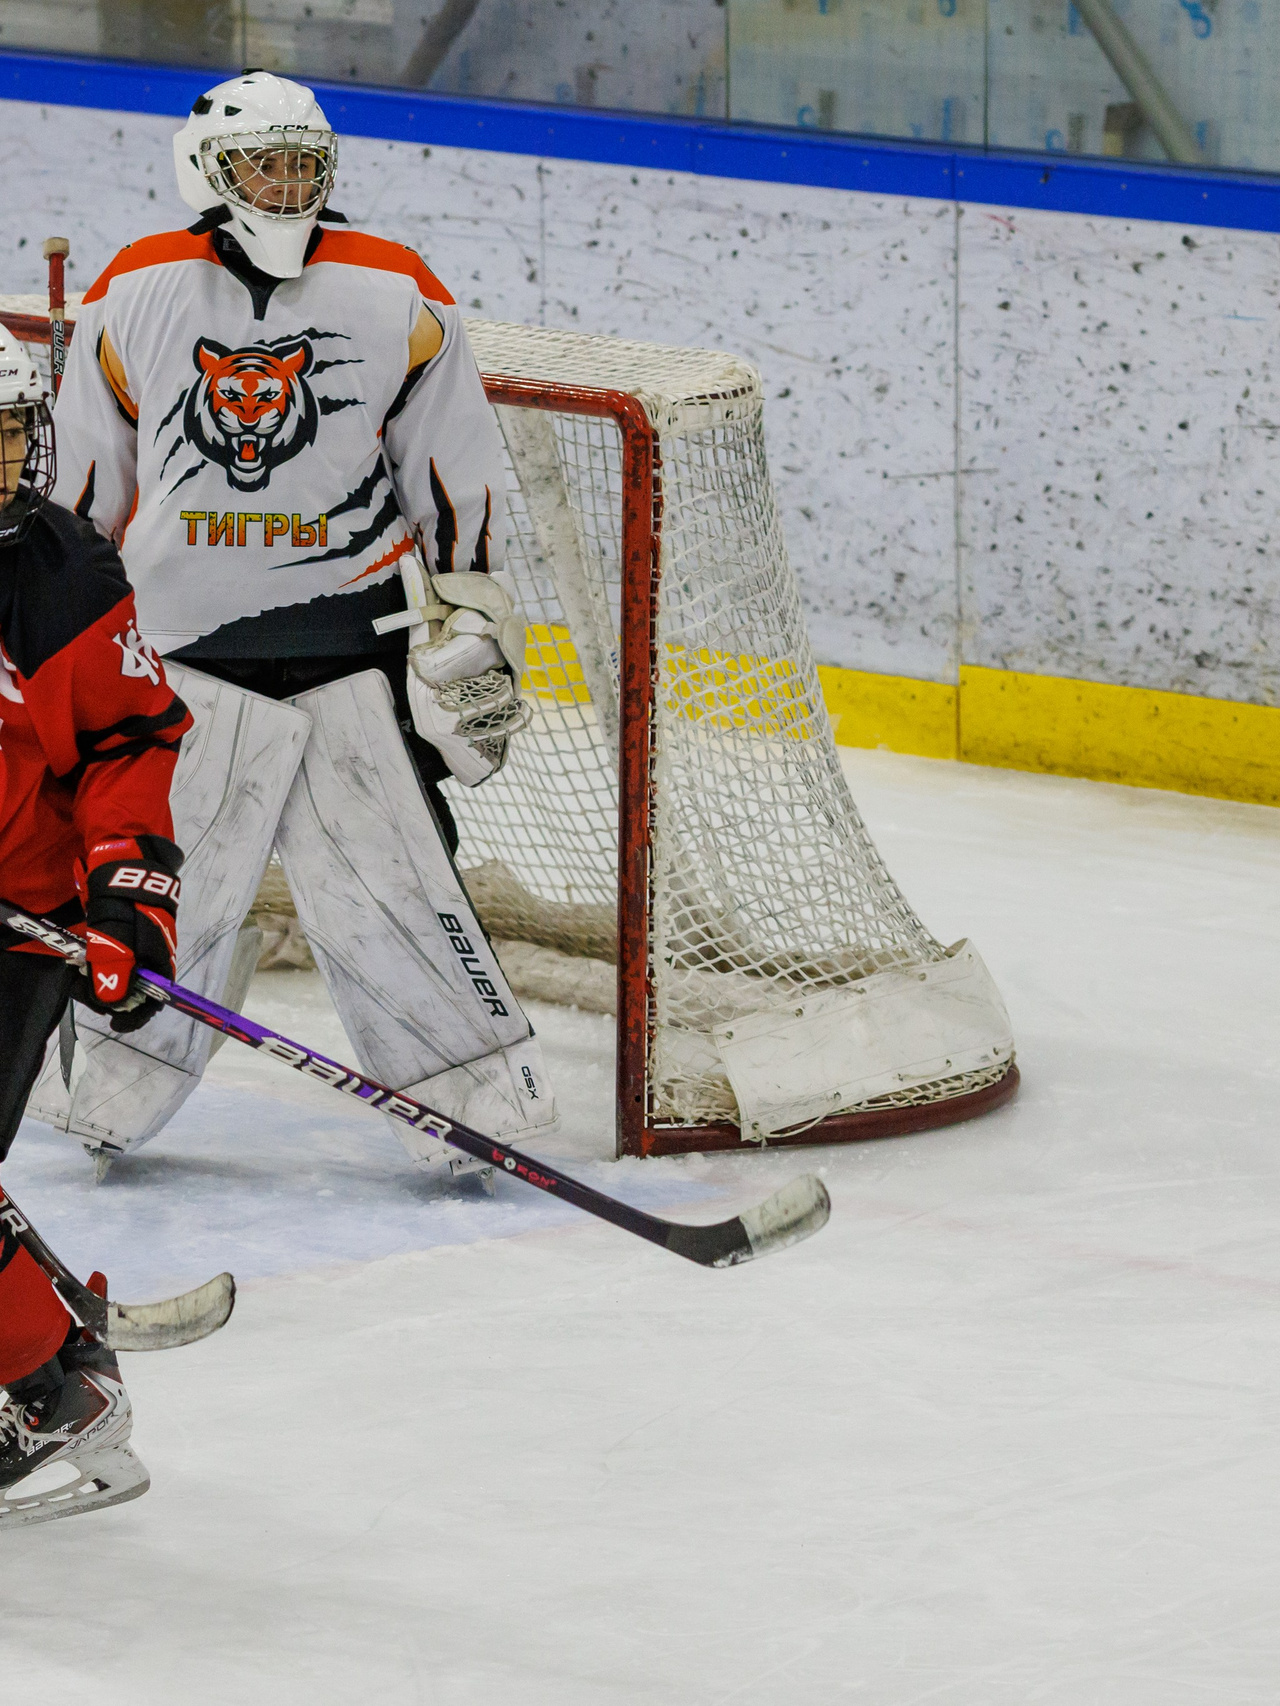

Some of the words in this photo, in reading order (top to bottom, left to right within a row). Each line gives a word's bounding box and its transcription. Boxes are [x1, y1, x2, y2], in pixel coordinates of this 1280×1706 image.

[53, 319, 66, 375] AUER
[179, 511, 328, 547] ТИГРЫ
[436, 912, 510, 1018] BAUER
[258, 1036, 454, 1143] BAUER
[521, 1065, 540, 1101] GSX
[69, 1412, 120, 1450] VAPOR
